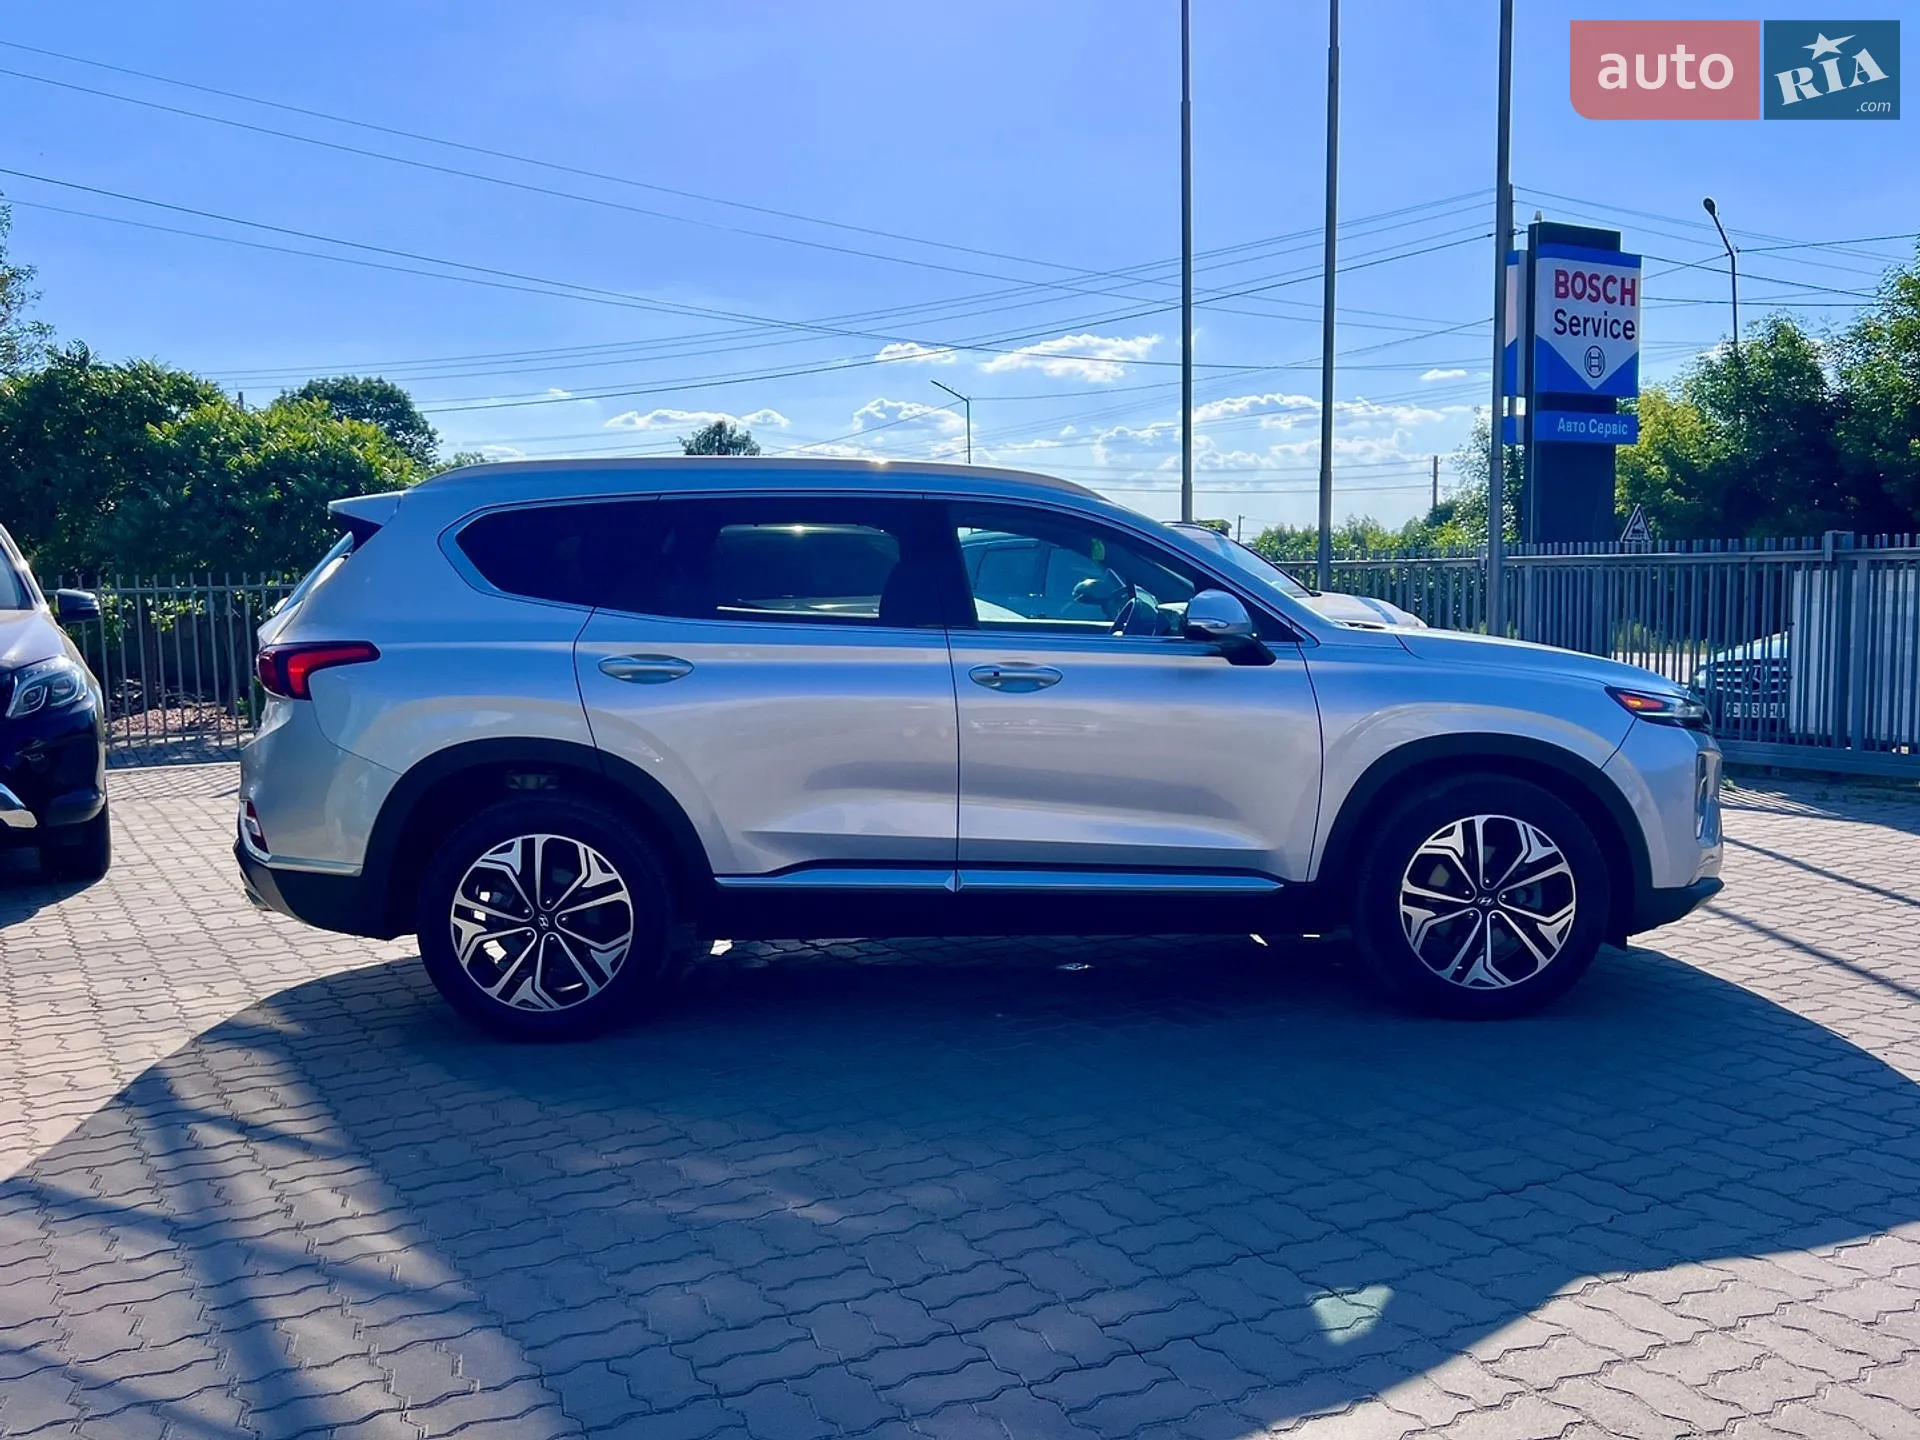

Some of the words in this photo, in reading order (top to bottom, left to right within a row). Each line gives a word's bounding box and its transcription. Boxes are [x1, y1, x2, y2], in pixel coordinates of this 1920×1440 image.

[1554, 269, 1636, 307] BOSCH
[1553, 308, 1636, 341] Service
[1557, 417, 1586, 433] Авто
[1588, 418, 1629, 438] Сервіс
